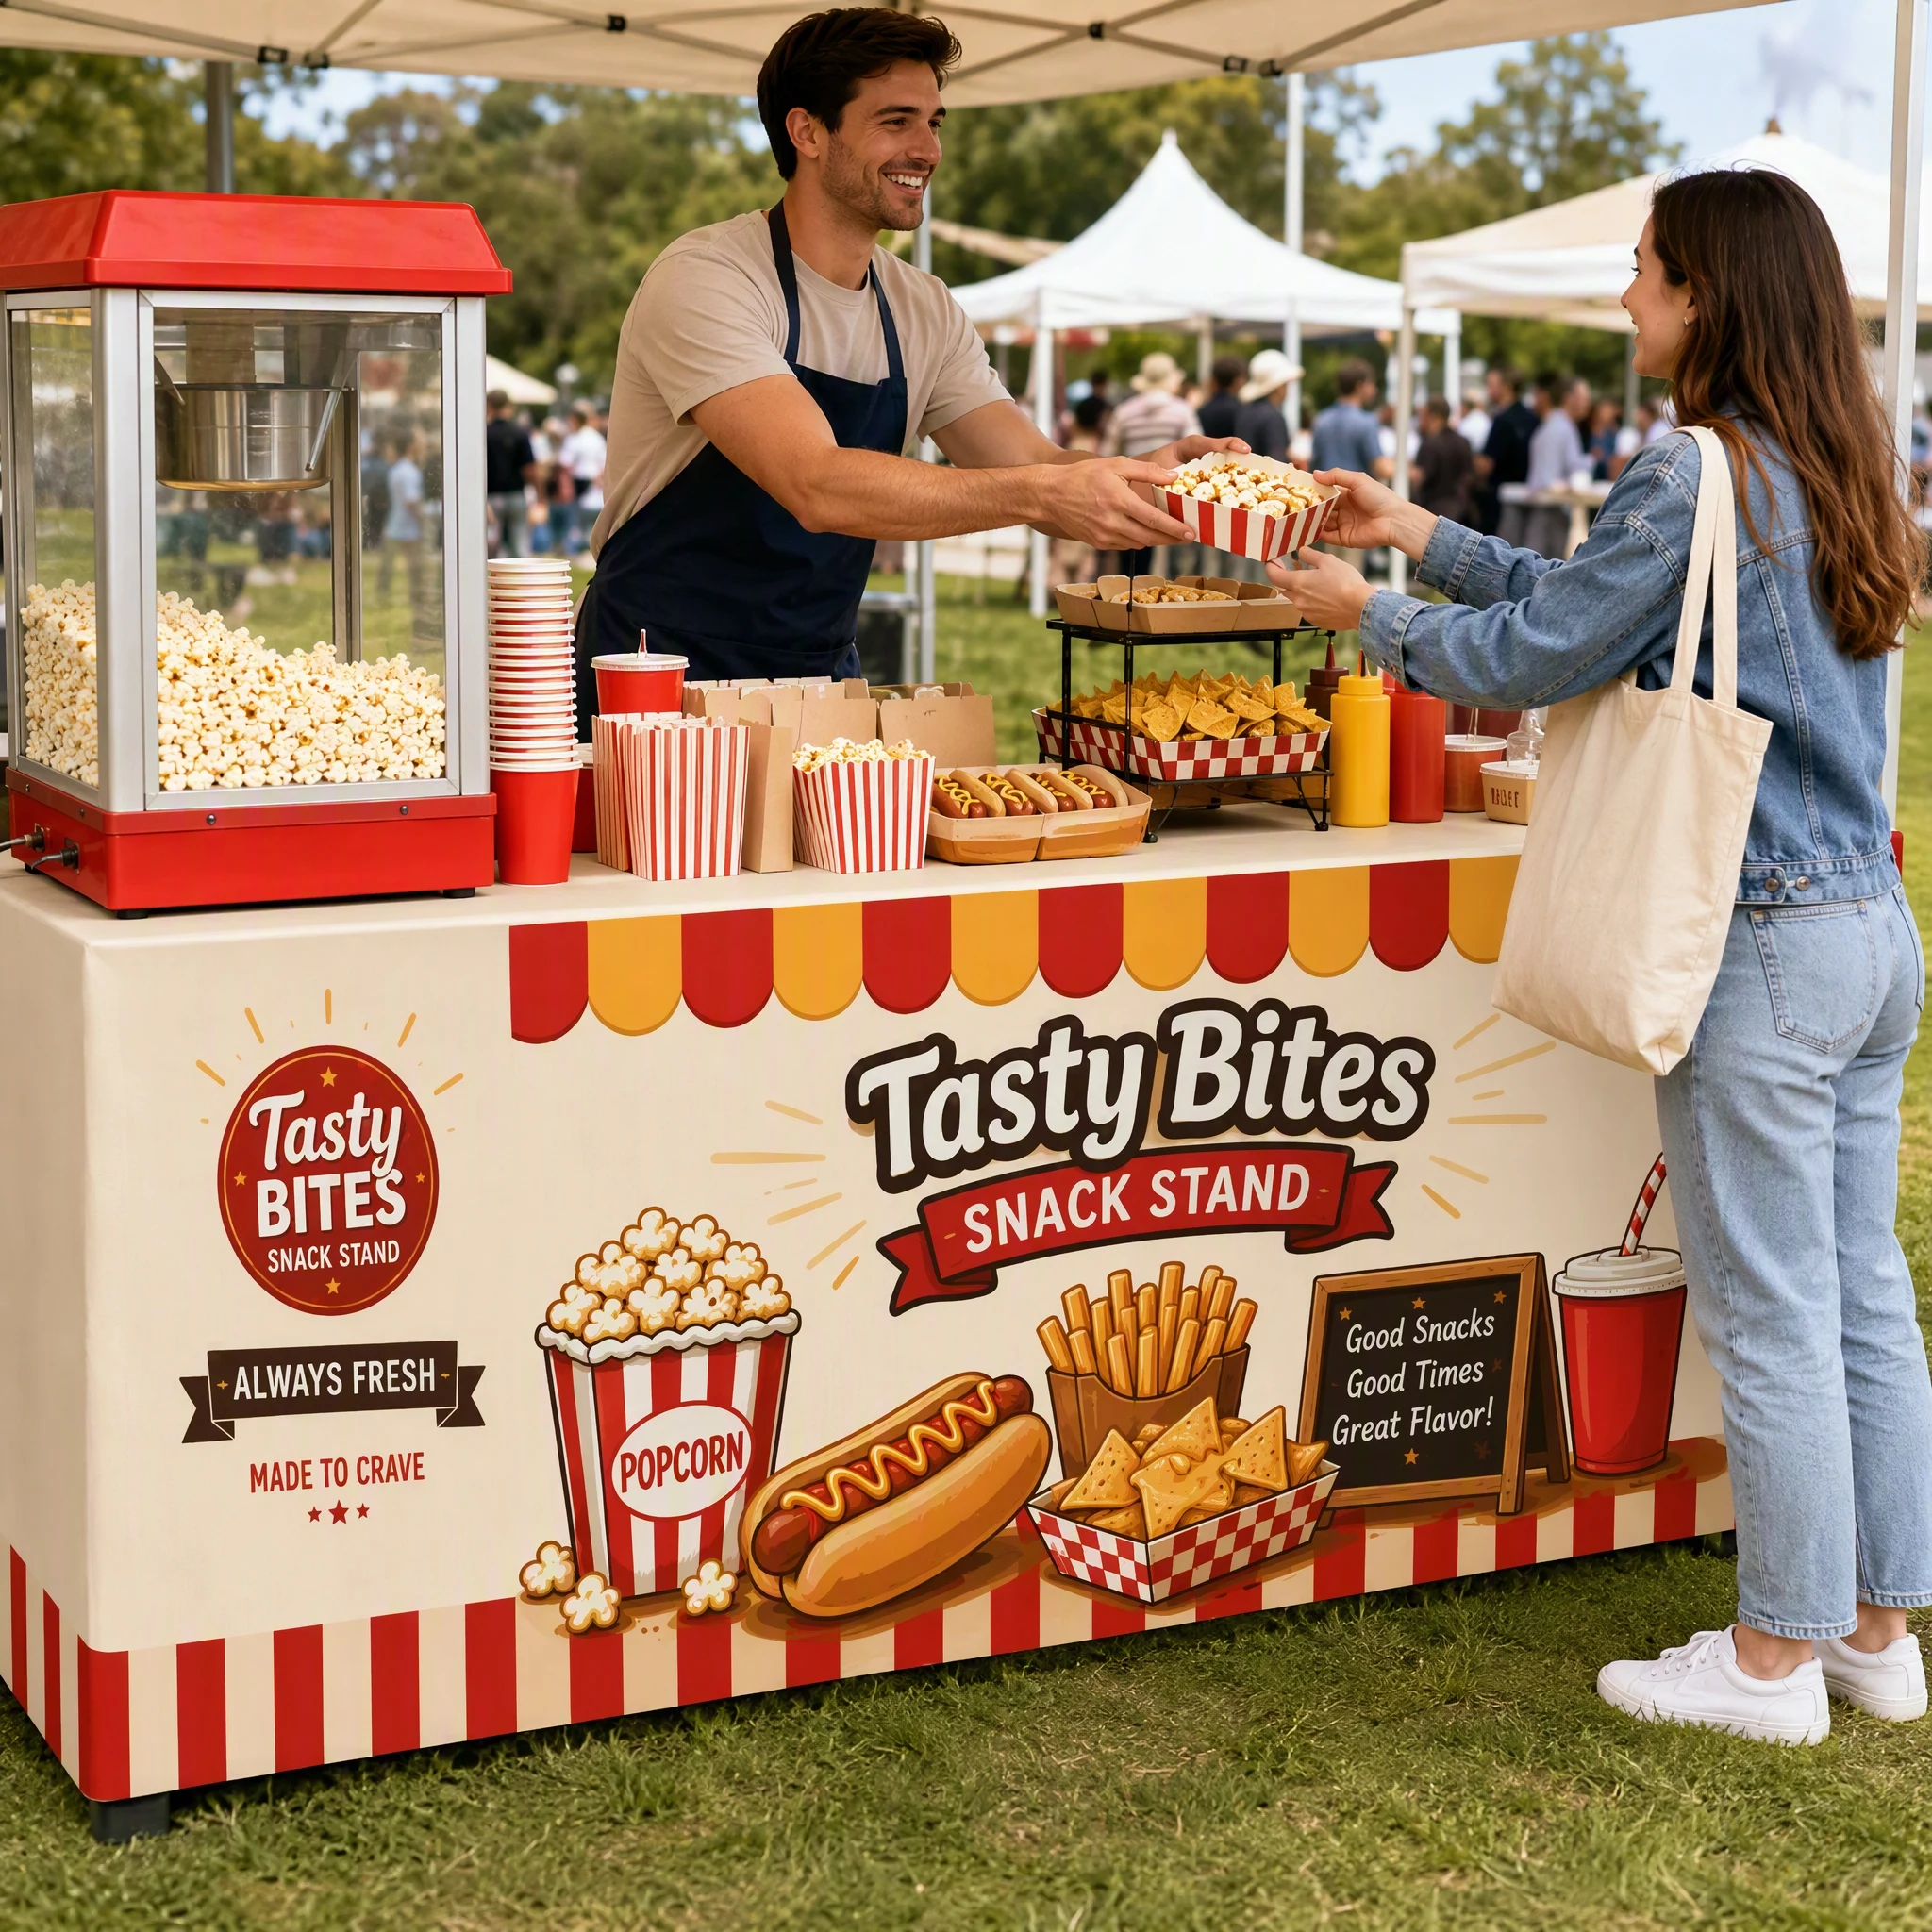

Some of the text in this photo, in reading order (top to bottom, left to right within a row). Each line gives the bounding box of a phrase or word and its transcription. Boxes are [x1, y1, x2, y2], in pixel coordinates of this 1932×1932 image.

[858, 1008, 1428, 1177] Tasty Bites
[247, 1088, 404, 1179] Tasty
[256, 1166, 408, 1238] BITES
[963, 1163, 1311, 1254] SNACK STAND
[266, 1240, 401, 1274] SNACK STAND
[1345, 1307, 1496, 1355] Good Snacks
[233, 1357, 436, 1401] ALWAYS FRESH
[1346, 1358, 1485, 1400] Good Times
[1331, 1394, 1495, 1447] Great Flavor!
[248, 1450, 426, 1494] MADE TO CRAVE
[619, 1429, 745, 1494] POPCORN
